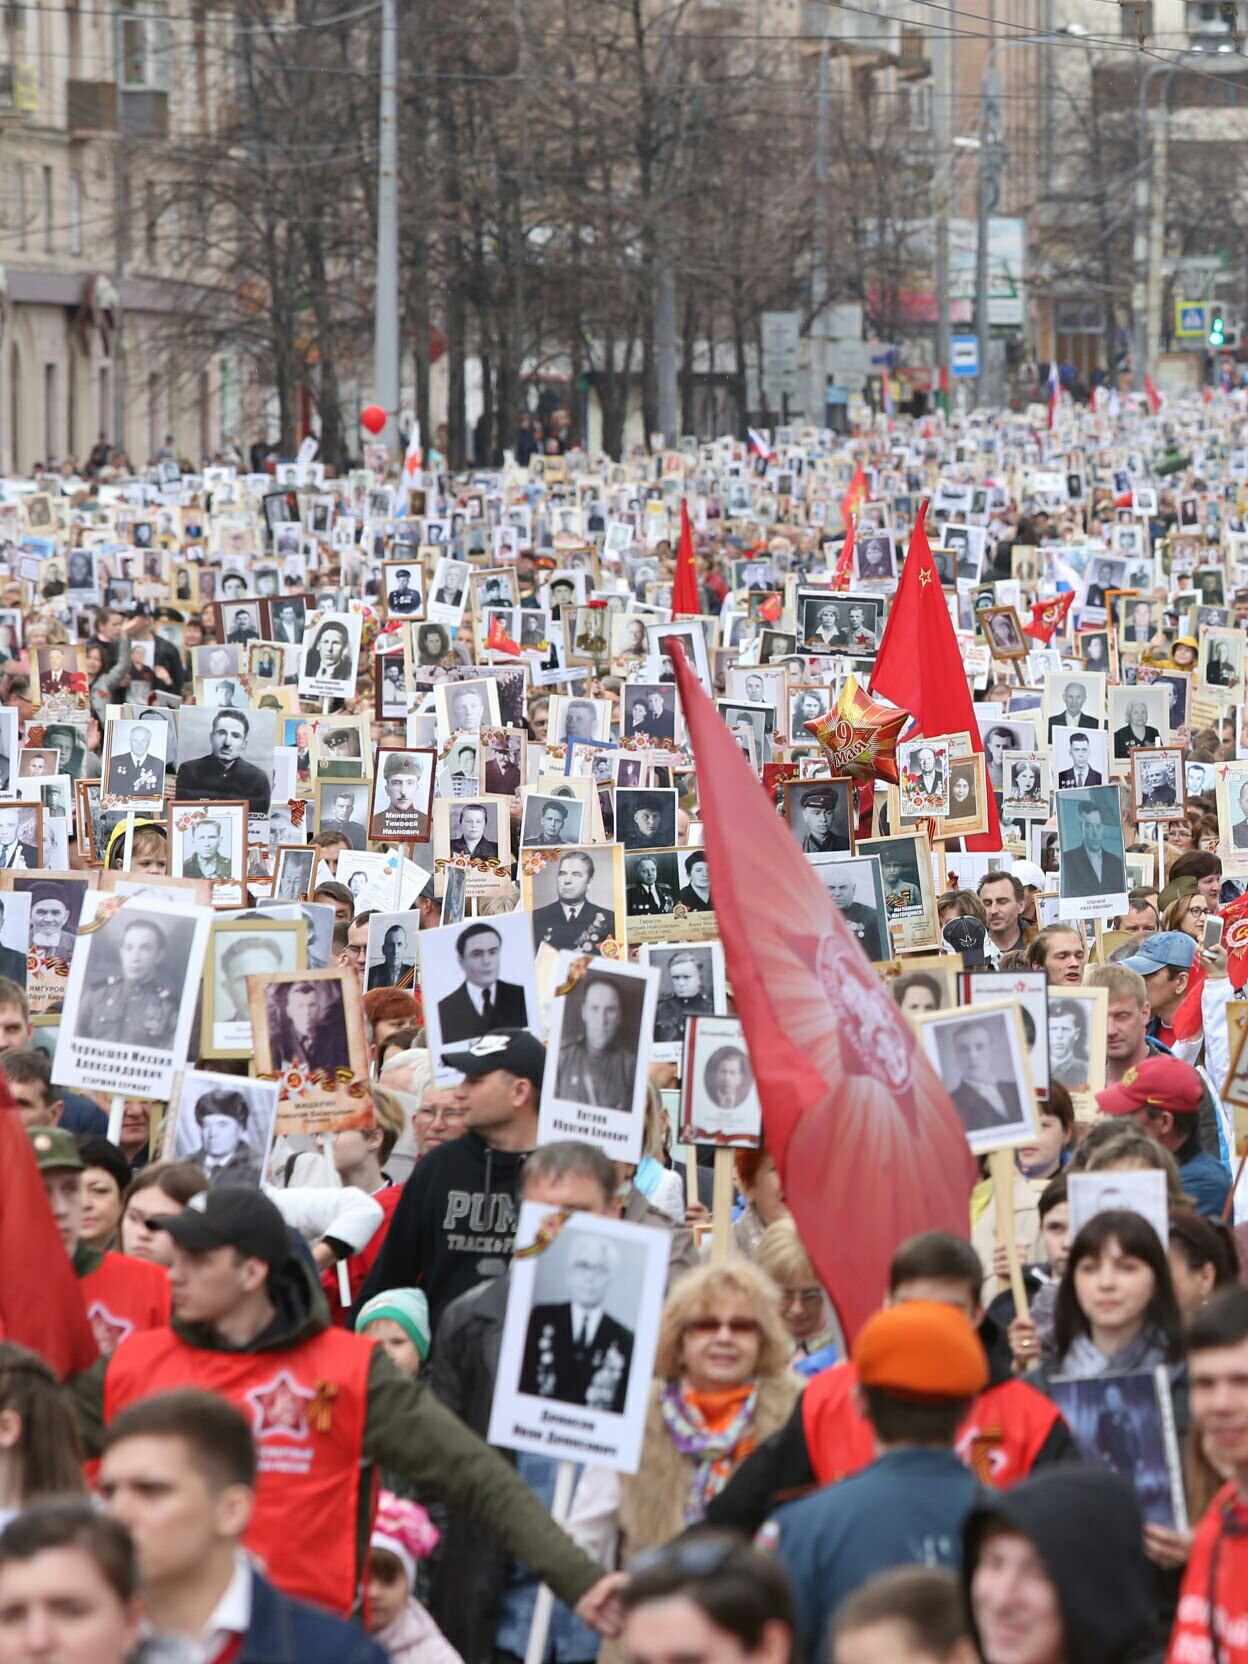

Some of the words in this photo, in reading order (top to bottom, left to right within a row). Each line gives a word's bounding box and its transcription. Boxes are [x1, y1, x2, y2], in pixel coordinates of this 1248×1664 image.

[835, 720, 853, 751] 9
[834, 740, 870, 768] Мая
[75, 1058, 163, 1081] Александрович
[442, 1189, 518, 1233] PUM
